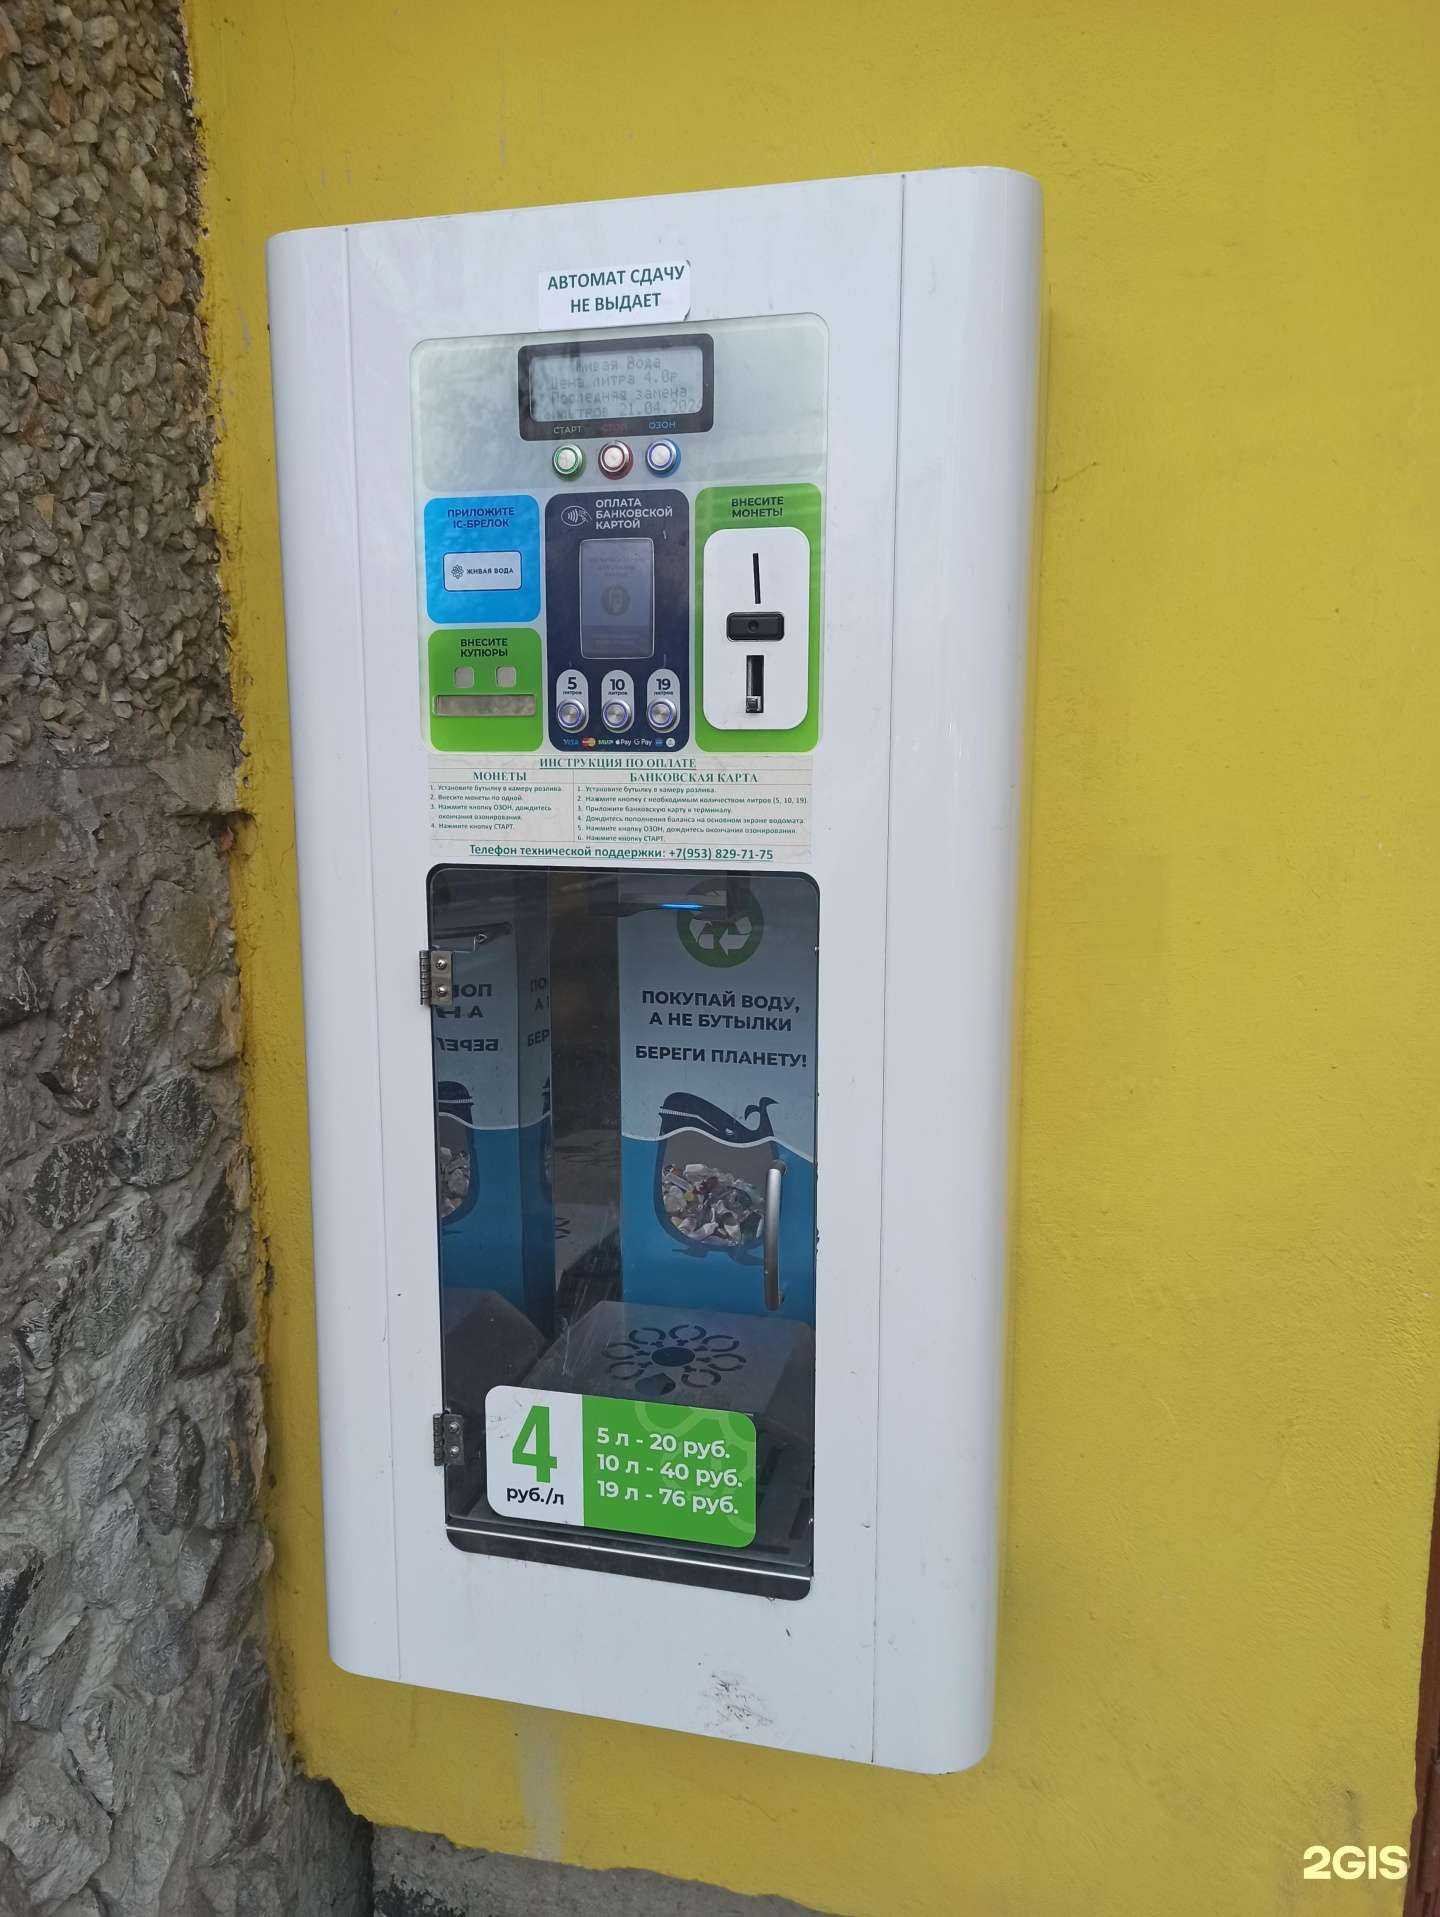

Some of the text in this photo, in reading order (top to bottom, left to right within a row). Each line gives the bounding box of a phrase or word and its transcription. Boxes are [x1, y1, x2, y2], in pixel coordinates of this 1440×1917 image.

[548, 265, 685, 290] АВТОМАТ СДАЧУ
[571, 293, 662, 313] НЕ ВЫДАЕТ
[554, 425, 583, 434] СТАРТ
[649, 420, 675, 430] ОЗОН
[595, 498, 641, 508] ОПЛАТА
[731, 496, 784, 507] ВНЕСИТЕ
[448, 507, 515, 518] ПРИЛОЖИТЕ
[595, 506, 673, 519] БАНКОВСКОЙ
[732, 508, 783, 518] МОНЕТЫ
[595, 519, 640, 530] КАРТОЙ
[460, 638, 508, 647] ВНЕСИТЕ
[460, 648, 508, 657] КУПЮРЫ
[567, 677, 577, 690] 5
[610, 678, 625, 691] 10
[656, 678, 671, 691] 19
[540, 758, 696, 768] ИНСТРУКЦИЯ ПО ОПЛАТЕ
[473, 771, 527, 781] МОНЕТЫ
[630, 773, 758, 783] БАНКОВСКАЯ КАРТА
[470, 845, 774, 860] Телефон технической поддержки: +7(953) 829-71-75
[642, 990, 800, 1013] ПОКУПАЙ ВОДУ,
[649, 1012, 792, 1031] А НЕ БУТЫЛКИ
[635, 1045, 807, 1068] БЕРЕГИ ПЛАНЕТУ!
[512, 1405, 558, 1484] 4
[597, 1427, 609, 1444] 5
[615, 1432, 629, 1446] л
[649, 1433, 677, 1452] 20
[684, 1438, 731, 1459] руб.
[597, 1453, 619, 1472] 10
[625, 1459, 639, 1474] л
[660, 1463, 689, 1481] 40
[696, 1468, 743, 1488] руб.
[506, 1486, 565, 1506] руб./л
[597, 1480, 619, 1498] 19
[624, 1485, 639, 1500] л
[659, 1488, 686, 1507] 76
[692, 1494, 739, 1515] руб.
